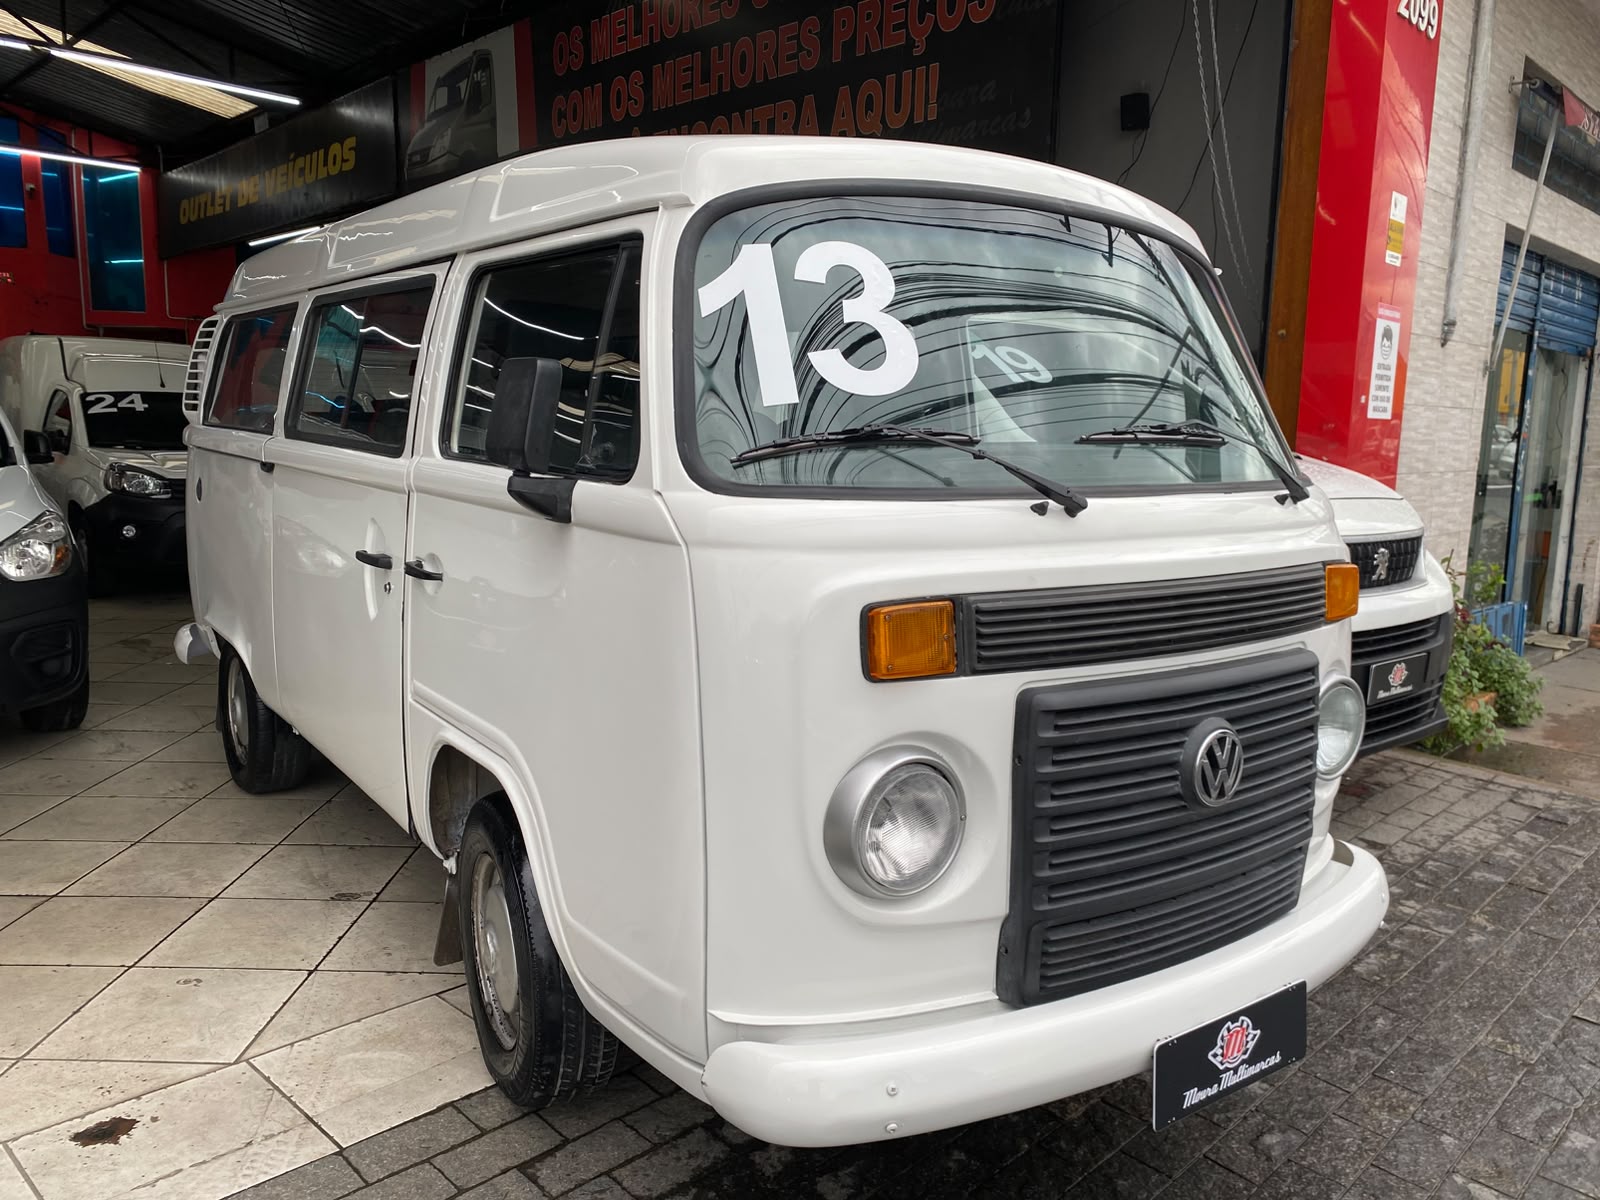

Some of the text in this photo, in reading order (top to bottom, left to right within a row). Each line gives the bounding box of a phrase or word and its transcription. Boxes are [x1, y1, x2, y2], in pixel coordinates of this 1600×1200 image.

[552, 25, 585, 76] OS
[552, 82, 603, 138] COM
[609, 70, 645, 122] OS
[652, 15, 821, 112] MELHORES
[831, 62, 940, 136] AQUI!
[179, 135, 357, 225] OUTLET DE VEÍCULOS
[698, 240, 919, 407] 13
[971, 344, 1053, 383] 19
[85, 393, 149, 414] 24
[1195, 729, 1243, 807] VW
[1182, 1051, 1282, 1109] Moura Multimarcas
